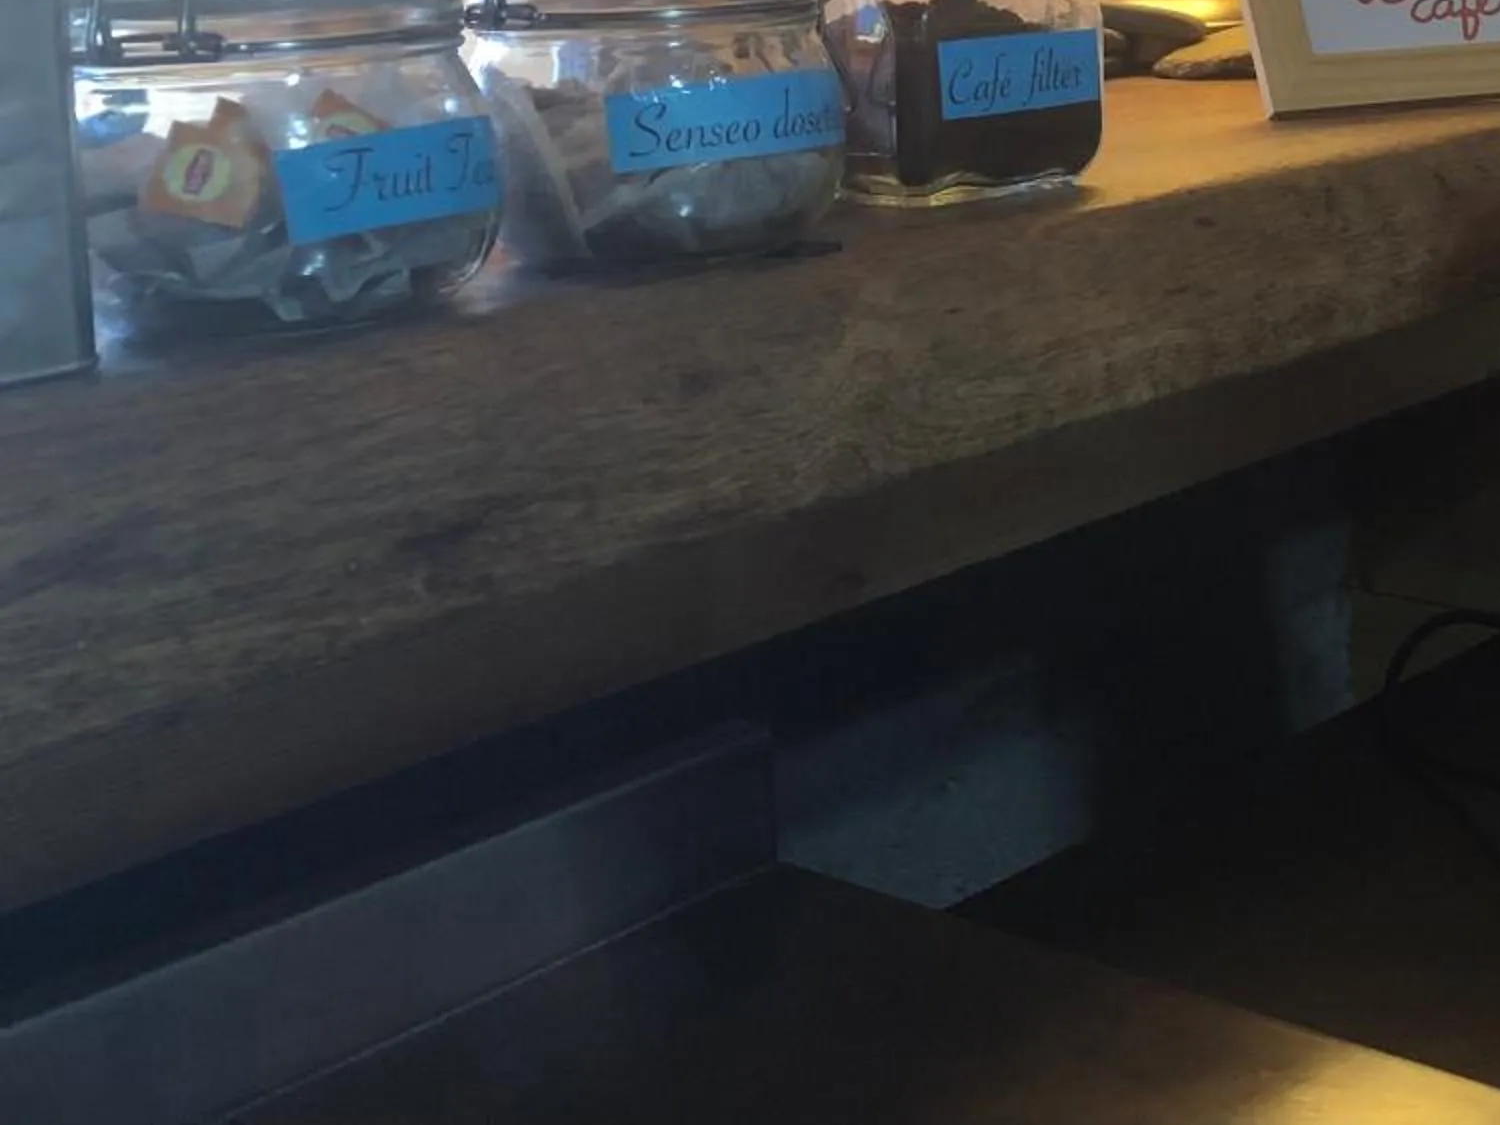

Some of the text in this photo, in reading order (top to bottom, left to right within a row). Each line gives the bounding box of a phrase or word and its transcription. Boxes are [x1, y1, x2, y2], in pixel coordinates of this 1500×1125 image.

[1022, 44, 1083, 107] filter
[628, 101, 762, 158] Senseo
[322, 146, 433, 213] Fruit
